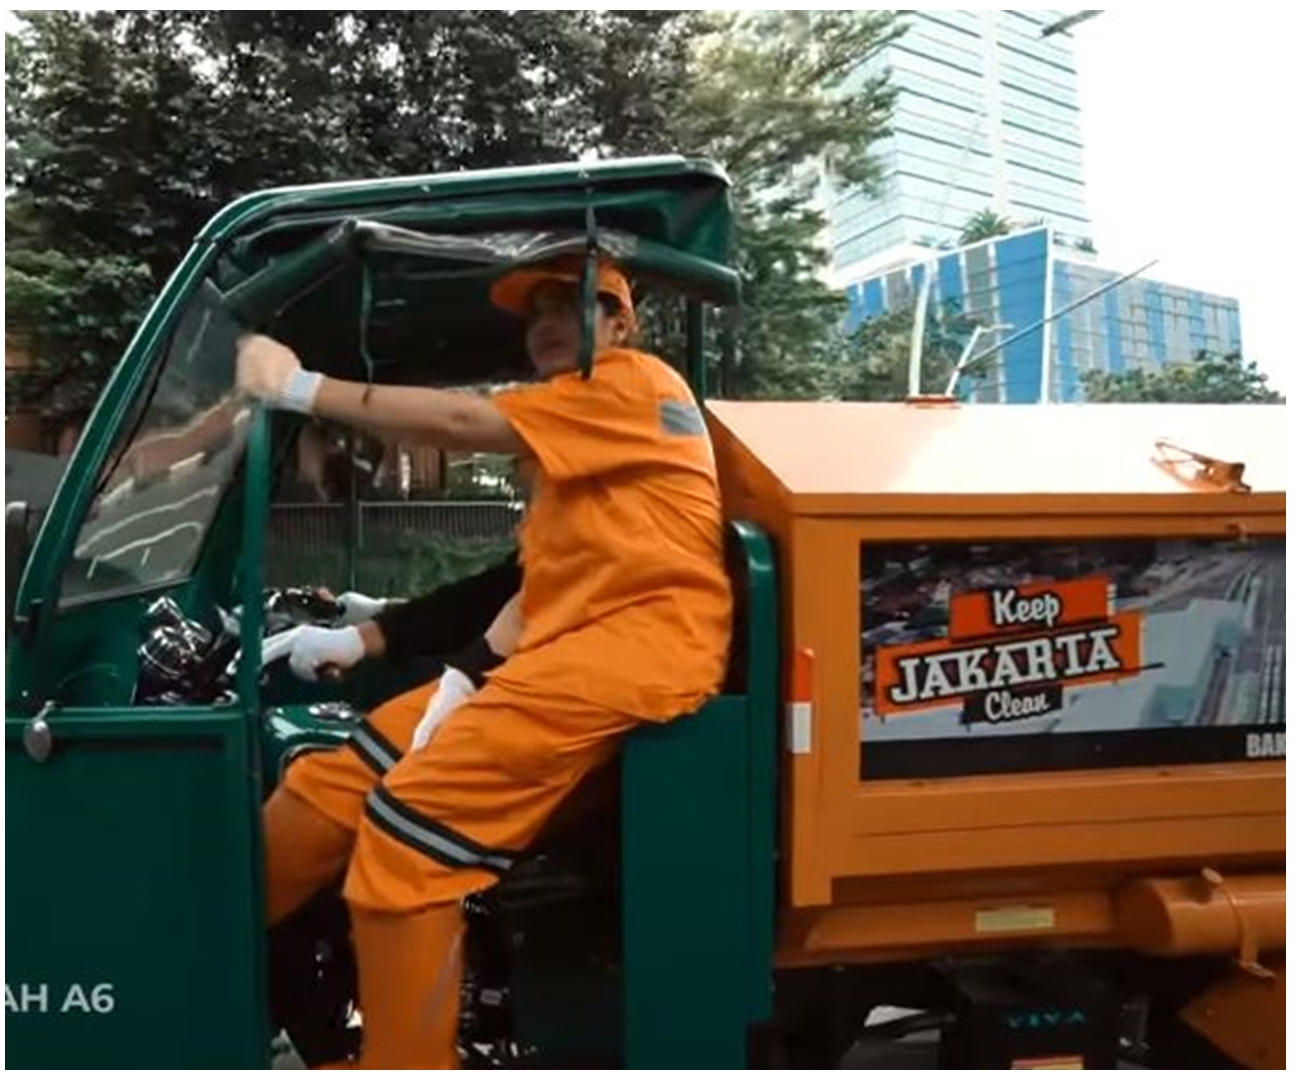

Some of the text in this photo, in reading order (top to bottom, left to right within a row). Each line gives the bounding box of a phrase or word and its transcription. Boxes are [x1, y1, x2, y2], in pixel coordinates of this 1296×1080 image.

[991, 589, 1060, 627] Keep
[890, 627, 1120, 703] JAKARTA
[984, 689, 1050, 721] Clean
